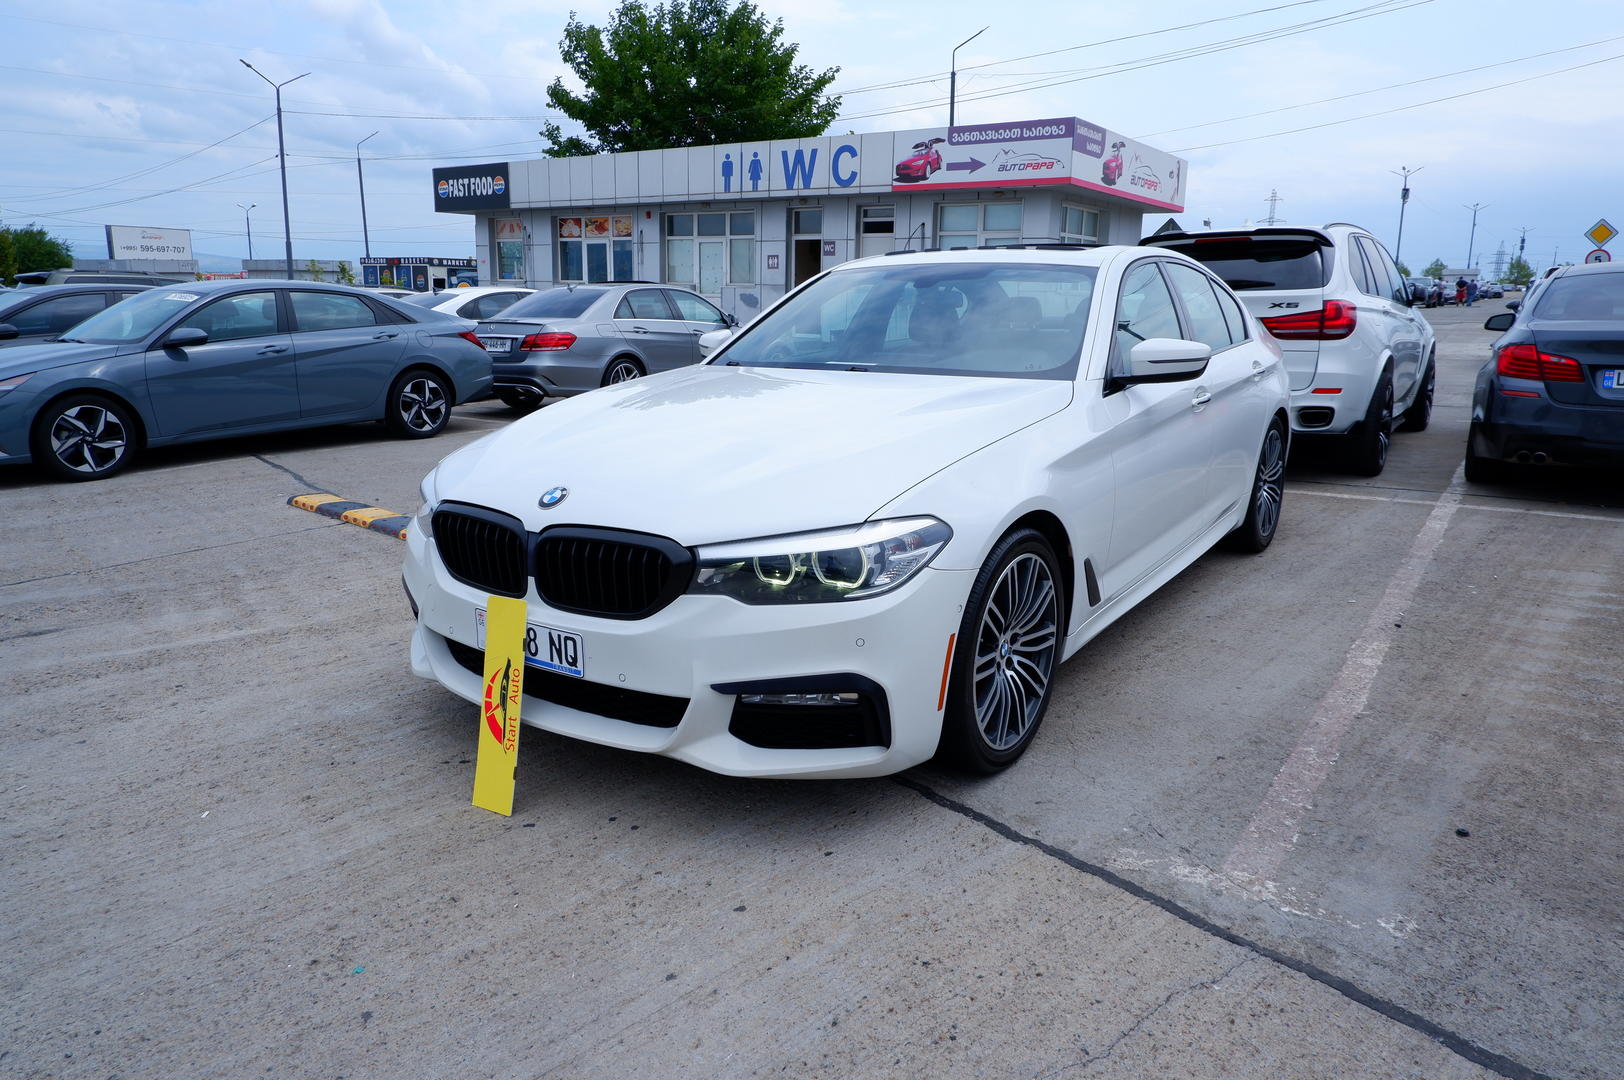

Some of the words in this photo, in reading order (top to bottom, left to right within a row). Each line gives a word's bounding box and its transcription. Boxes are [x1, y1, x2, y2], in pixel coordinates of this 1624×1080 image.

[448, 178, 469, 198] FAST
[470, 176, 493, 196] FOOD
[140, 244, 185, 254] 595-697-707
[824, 244, 835, 252] WC
[548, 631, 578, 668] NQ
[509, 668, 521, 704] Auto
[505, 716, 518, 752] Start
